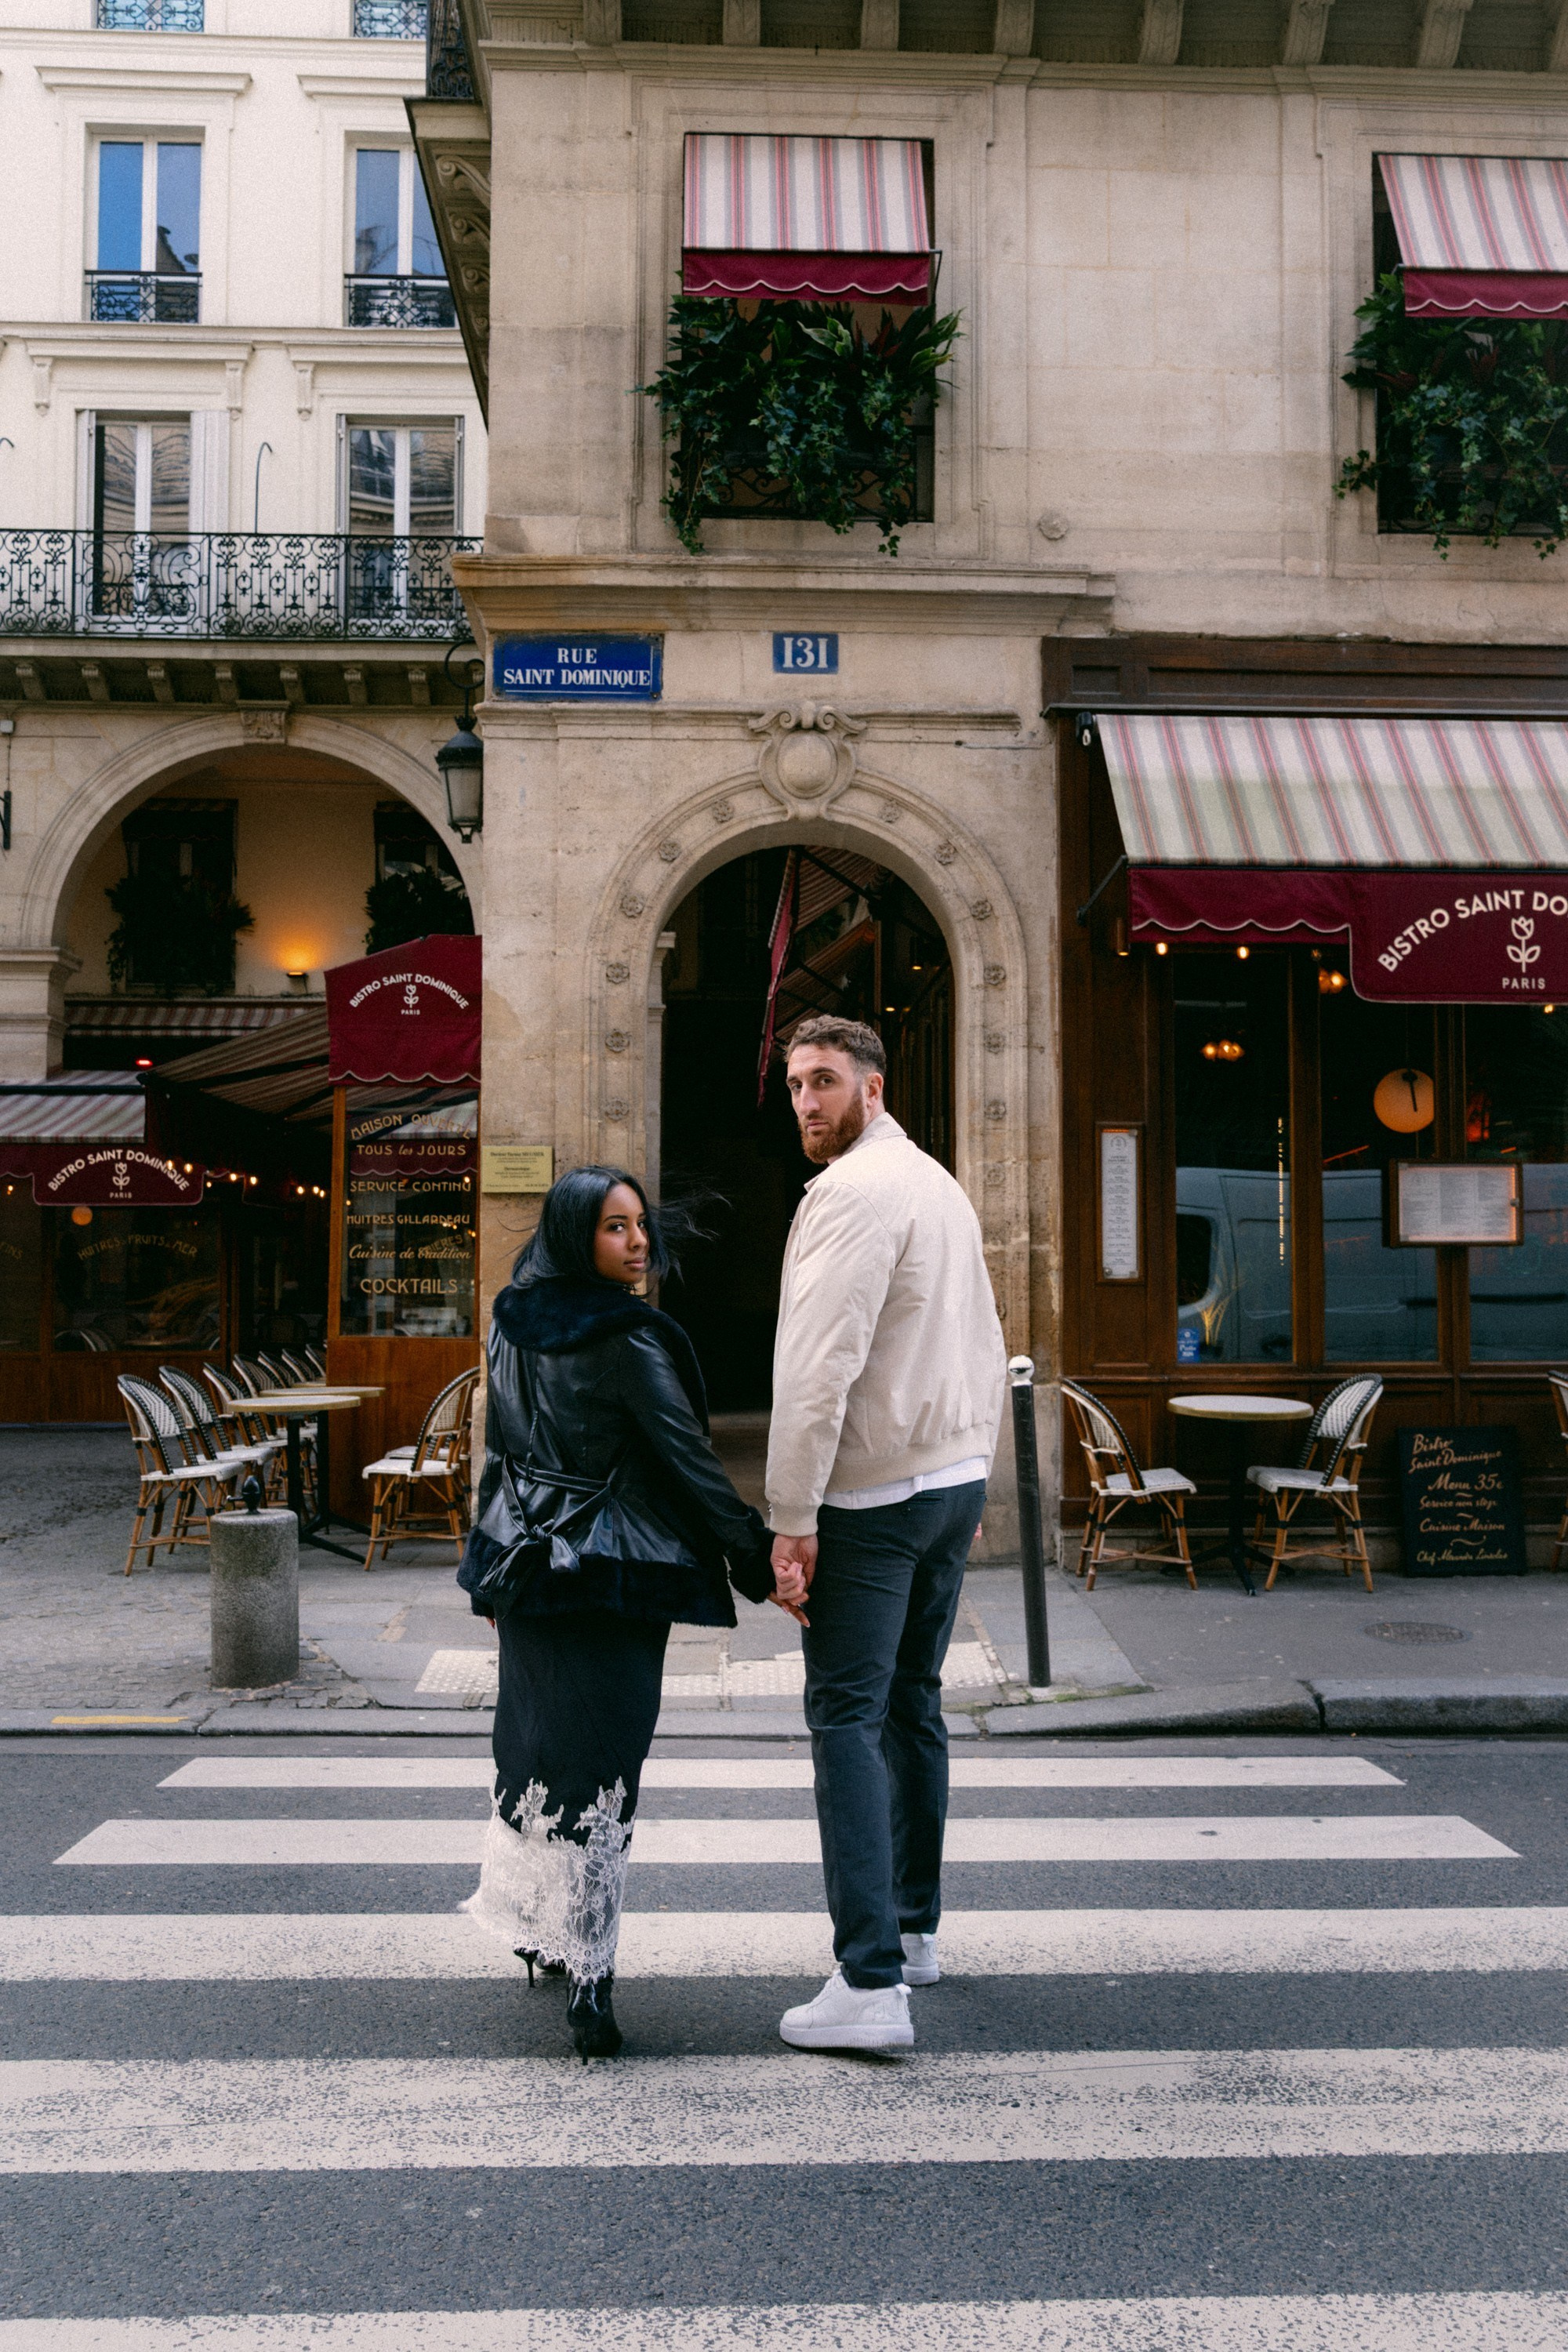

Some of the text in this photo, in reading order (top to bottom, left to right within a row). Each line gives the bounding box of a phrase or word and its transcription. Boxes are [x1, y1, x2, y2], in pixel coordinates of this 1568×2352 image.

[557, 648, 597, 664] RUE
[782, 637, 829, 669] 131
[503, 669, 650, 688] SAINT DOMINIQUE
[1377, 890, 1568, 972] BISTRO SAINT DO
[349, 973, 470, 1010] BISTRO SAINT DOMINIQUE
[1502, 977, 1546, 989] PARIS
[350, 1113, 470, 1140] MAISON OUVERTE
[356, 1144, 466, 1156] TOUS les JOURS
[48, 1149, 190, 1192] BISTRO SAINT DOMINIQUE
[350, 1181, 471, 1192] SERVICE CONTINU
[397, 1214, 470, 1225] GILLARDEAU
[349, 1243, 472, 1259] Cuisine de Tradition
[360, 1278, 458, 1294] COCKTAILS
[1412, 1433, 1454, 1455] Bistro
[1407, 1448, 1503, 1475] Saint Dominique
[1427, 1472, 1471, 1491] Menu
[1419, 1495, 1454, 1510] Service
[1419, 1517, 1505, 1533] Cuisine Maison
